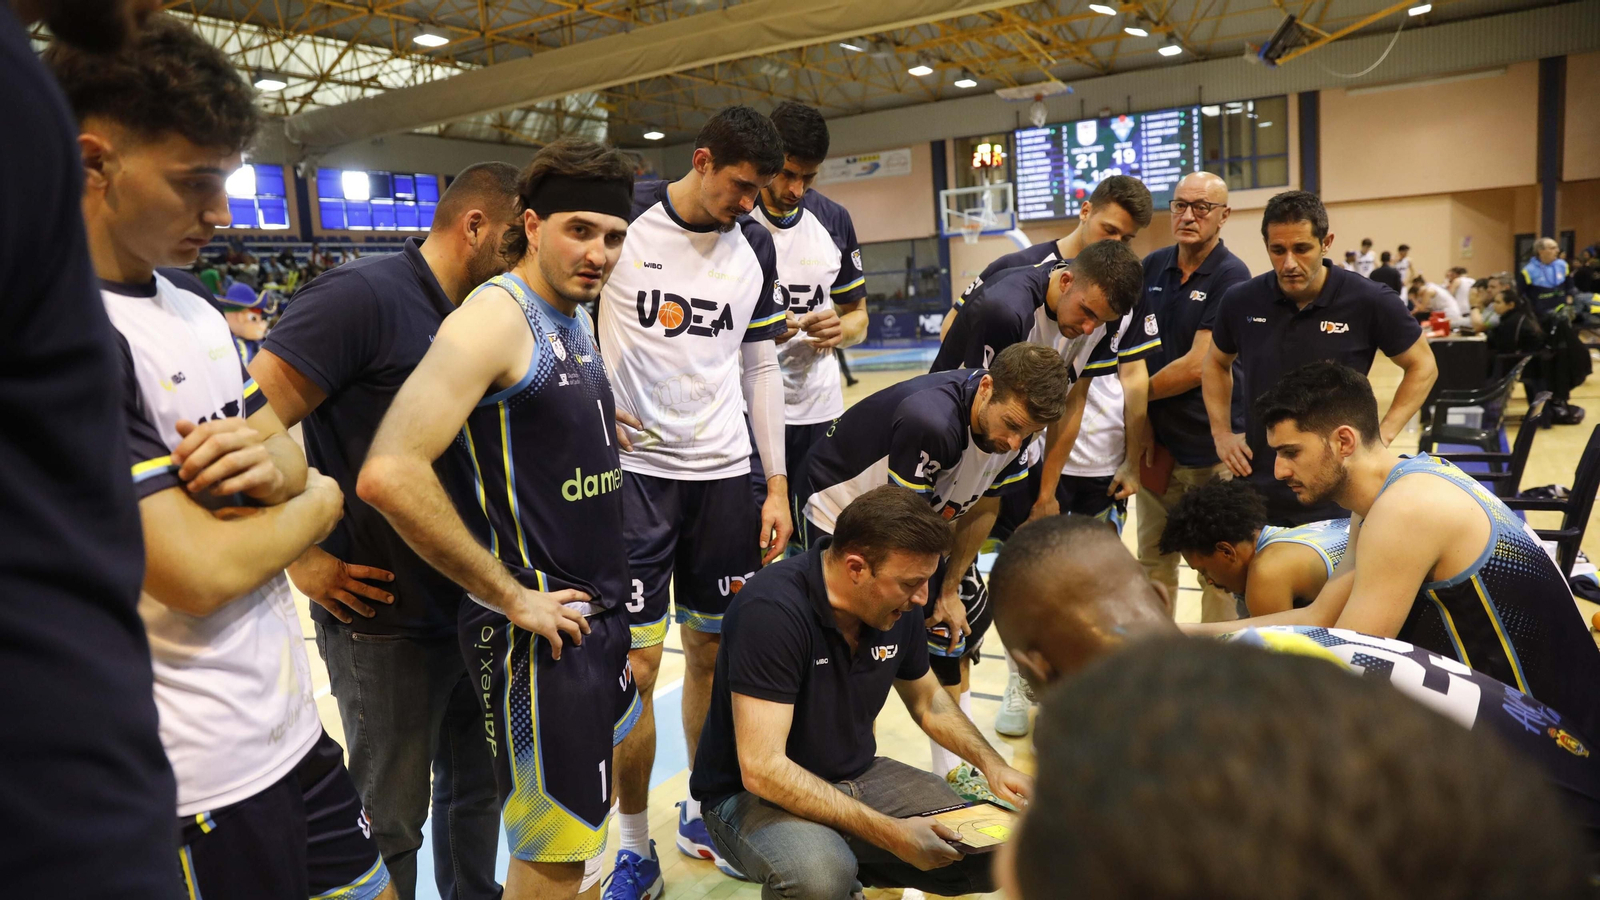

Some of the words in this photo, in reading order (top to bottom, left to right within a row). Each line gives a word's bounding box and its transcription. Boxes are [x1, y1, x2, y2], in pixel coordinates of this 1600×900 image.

[1075, 152, 1098, 170] 21
[1112, 148, 1136, 165] 19
[643, 262, 663, 270] WIBO
[636, 289, 734, 338] UDEA
[1320, 320, 1350, 335] UDEA
[597, 399, 610, 446] 1
[625, 578, 645, 613] 3
[871, 644, 898, 662] UDEA
[598, 759, 607, 803] 1
